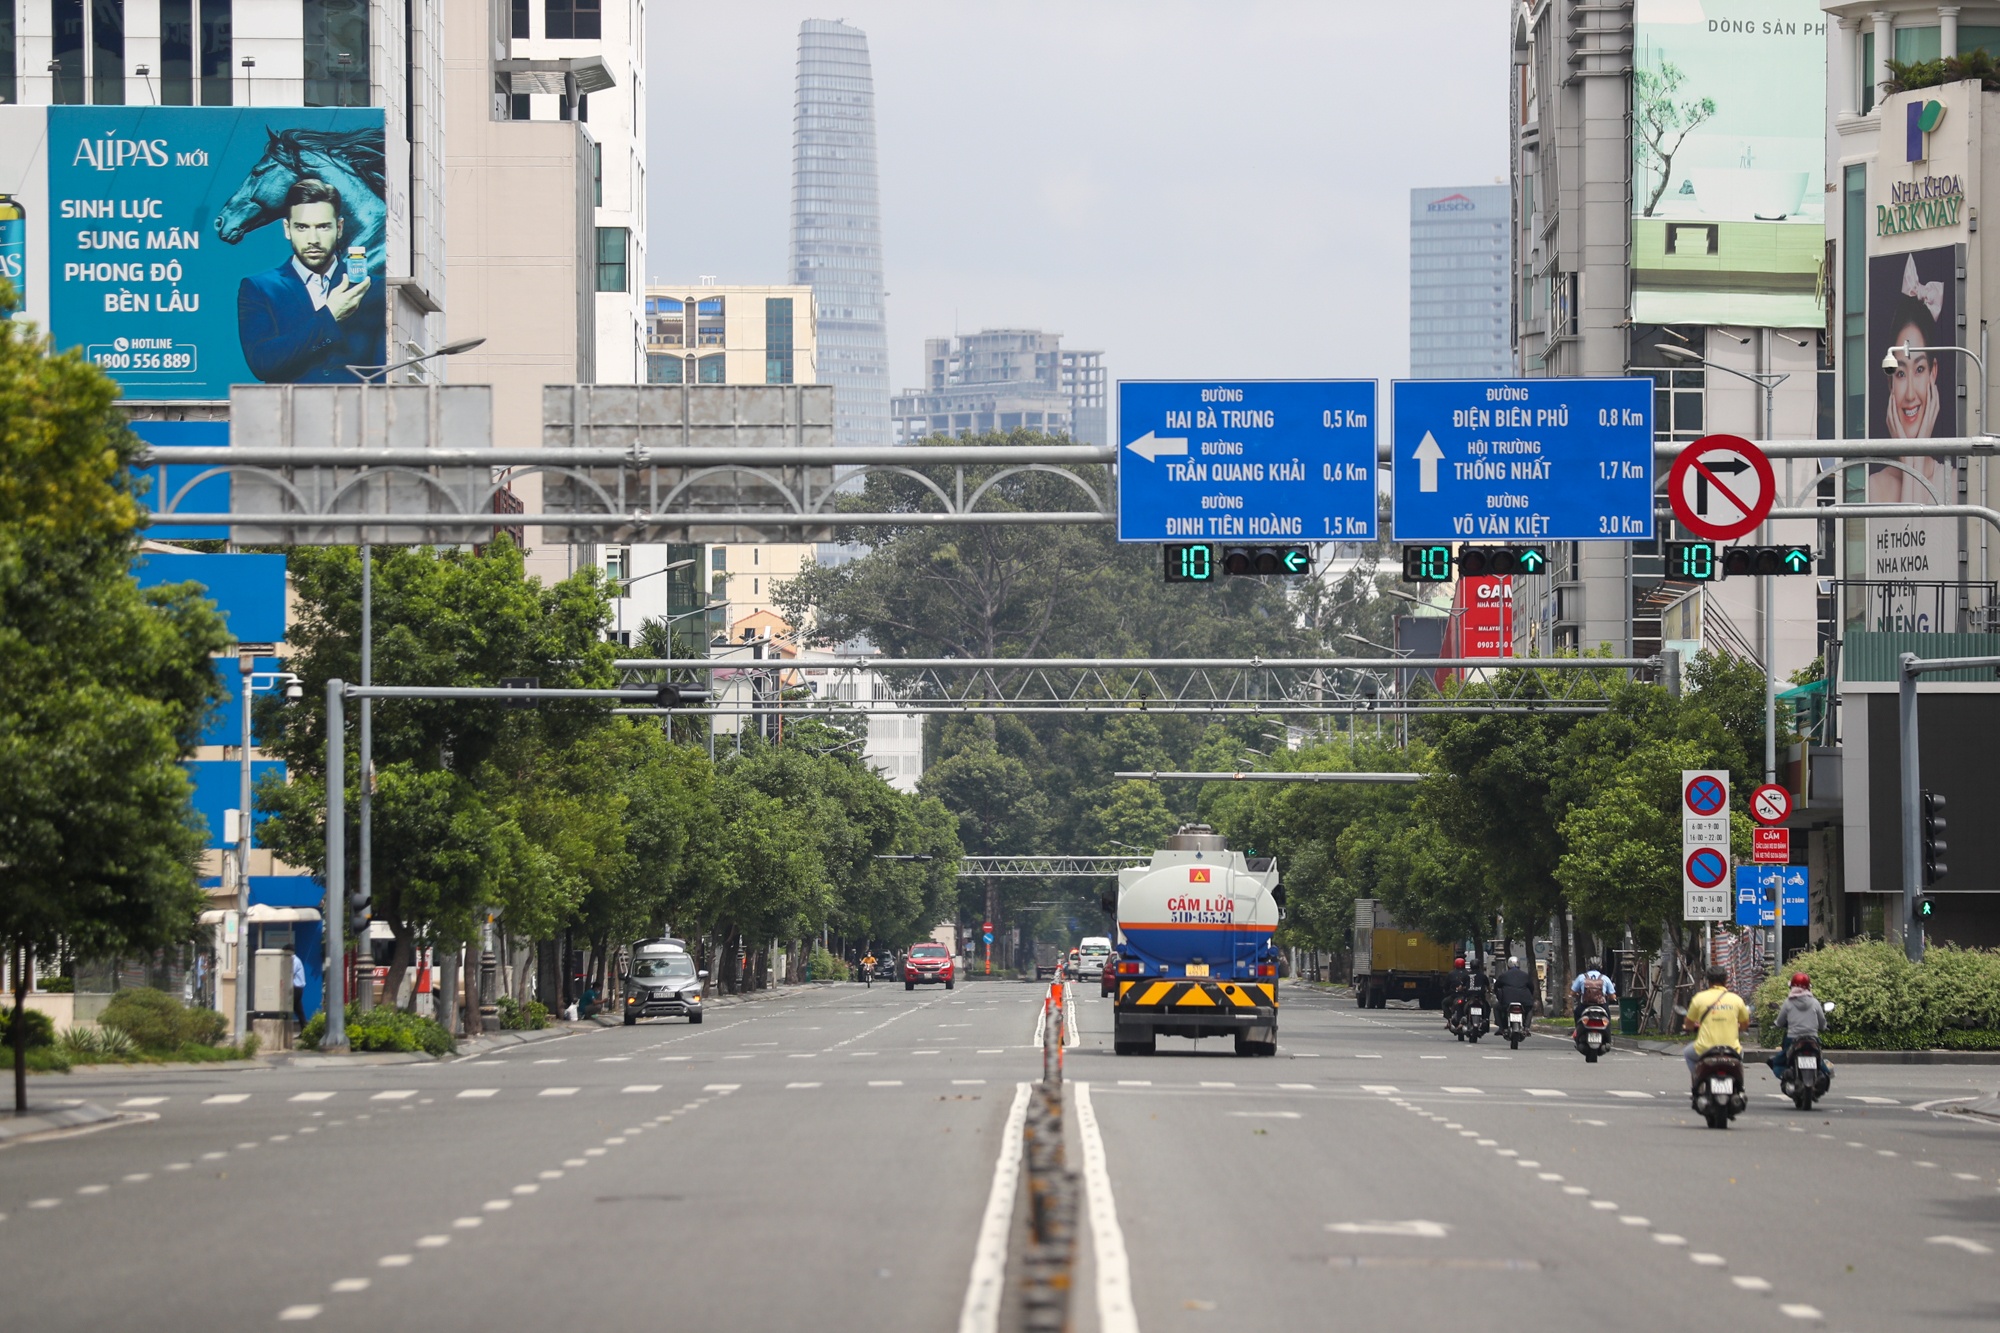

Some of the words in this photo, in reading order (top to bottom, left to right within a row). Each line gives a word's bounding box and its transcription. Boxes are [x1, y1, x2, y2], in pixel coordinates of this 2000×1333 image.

[1708, 17, 1755, 34] DÒNG
[1762, 18, 1796, 34] SẢN
[176, 148, 208, 166] MỚI
[1892, 181, 1922, 204] NHA
[1924, 174, 1961, 198] KHOA
[61, 200, 114, 218] SINH
[121, 198, 162, 223] LỰC
[1876, 196, 1960, 236] PARKWAY
[78, 230, 140, 249] SUNG
[146, 227, 199, 249] MÃN
[65, 263, 144, 282] PHONG
[150, 258, 182, 286] ĐỘ
[104, 288, 150, 312] BỀN
[156, 289, 199, 312] LÂU
[131, 338, 172, 349] HOTLINE
[94, 354, 130, 368] 1800
[133, 354, 160, 368] 556
[163, 354, 190, 368] 889
[1201, 386, 1243, 402] ĐƯỜNG
[1486, 385, 1529, 401] ĐƯỜNG
[1166, 411, 1191, 428] HAI
[1197, 406, 1217, 428] BÀ
[1222, 410, 1274, 428] TRƯNG
[1323, 410, 1342, 429] 0,5
[1346, 410, 1367, 428] Km
[1453, 406, 1490, 430] ĐIỆN
[1495, 406, 1531, 427] BIÊN
[1537, 404, 1569, 426] PHỦ
[1599, 408, 1618, 428] 0,8
[1622, 408, 1643, 426] Km
[1201, 439, 1243, 455] ĐƯỜNG
[1468, 439, 1488, 457] HỘI
[1491, 438, 1541, 454] TRƯỜNG
[1166, 456, 1207, 481] TRẦN
[1212, 464, 1264, 482] QUANG
[1269, 458, 1305, 481] KHẢI
[1323, 464, 1342, 482] 0,6
[1346, 464, 1367, 481] Km
[1454, 456, 1506, 480] THỐNG
[1510, 455, 1552, 480] NHẤT
[1599, 462, 1618, 481] 1,7
[1622, 462, 1643, 479] Km
[1201, 493, 1243, 509] ĐƯỜNG
[1486, 493, 1529, 508] ĐƯỜNG
[1166, 517, 1203, 535] ĐINH
[1208, 514, 1243, 535] TIÊN
[1249, 513, 1302, 534] HOÀNG
[1323, 516, 1342, 536] 1,5
[1346, 516, 1367, 534] Km
[1453, 513, 1474, 534] VÕ
[1478, 514, 1510, 534] VĂN
[1514, 513, 1550, 537] KIỆT
[1599, 516, 1618, 536] 3,0
[1622, 516, 1643, 533] Km
[1877, 528, 1888, 553] HỆ
[1890, 524, 1926, 548] THỐNG
[1181, 545, 1210, 579] 10
[1420, 546, 1448, 579] 10
[1683, 544, 1711, 578] 10
[1877, 558, 1898, 574] NHA
[1900, 555, 1929, 572] KHOA
[1763, 830, 1780, 839] CẤM
[1168, 894, 1200, 911] CẤM
[1206, 894, 1234, 912] LỬA
